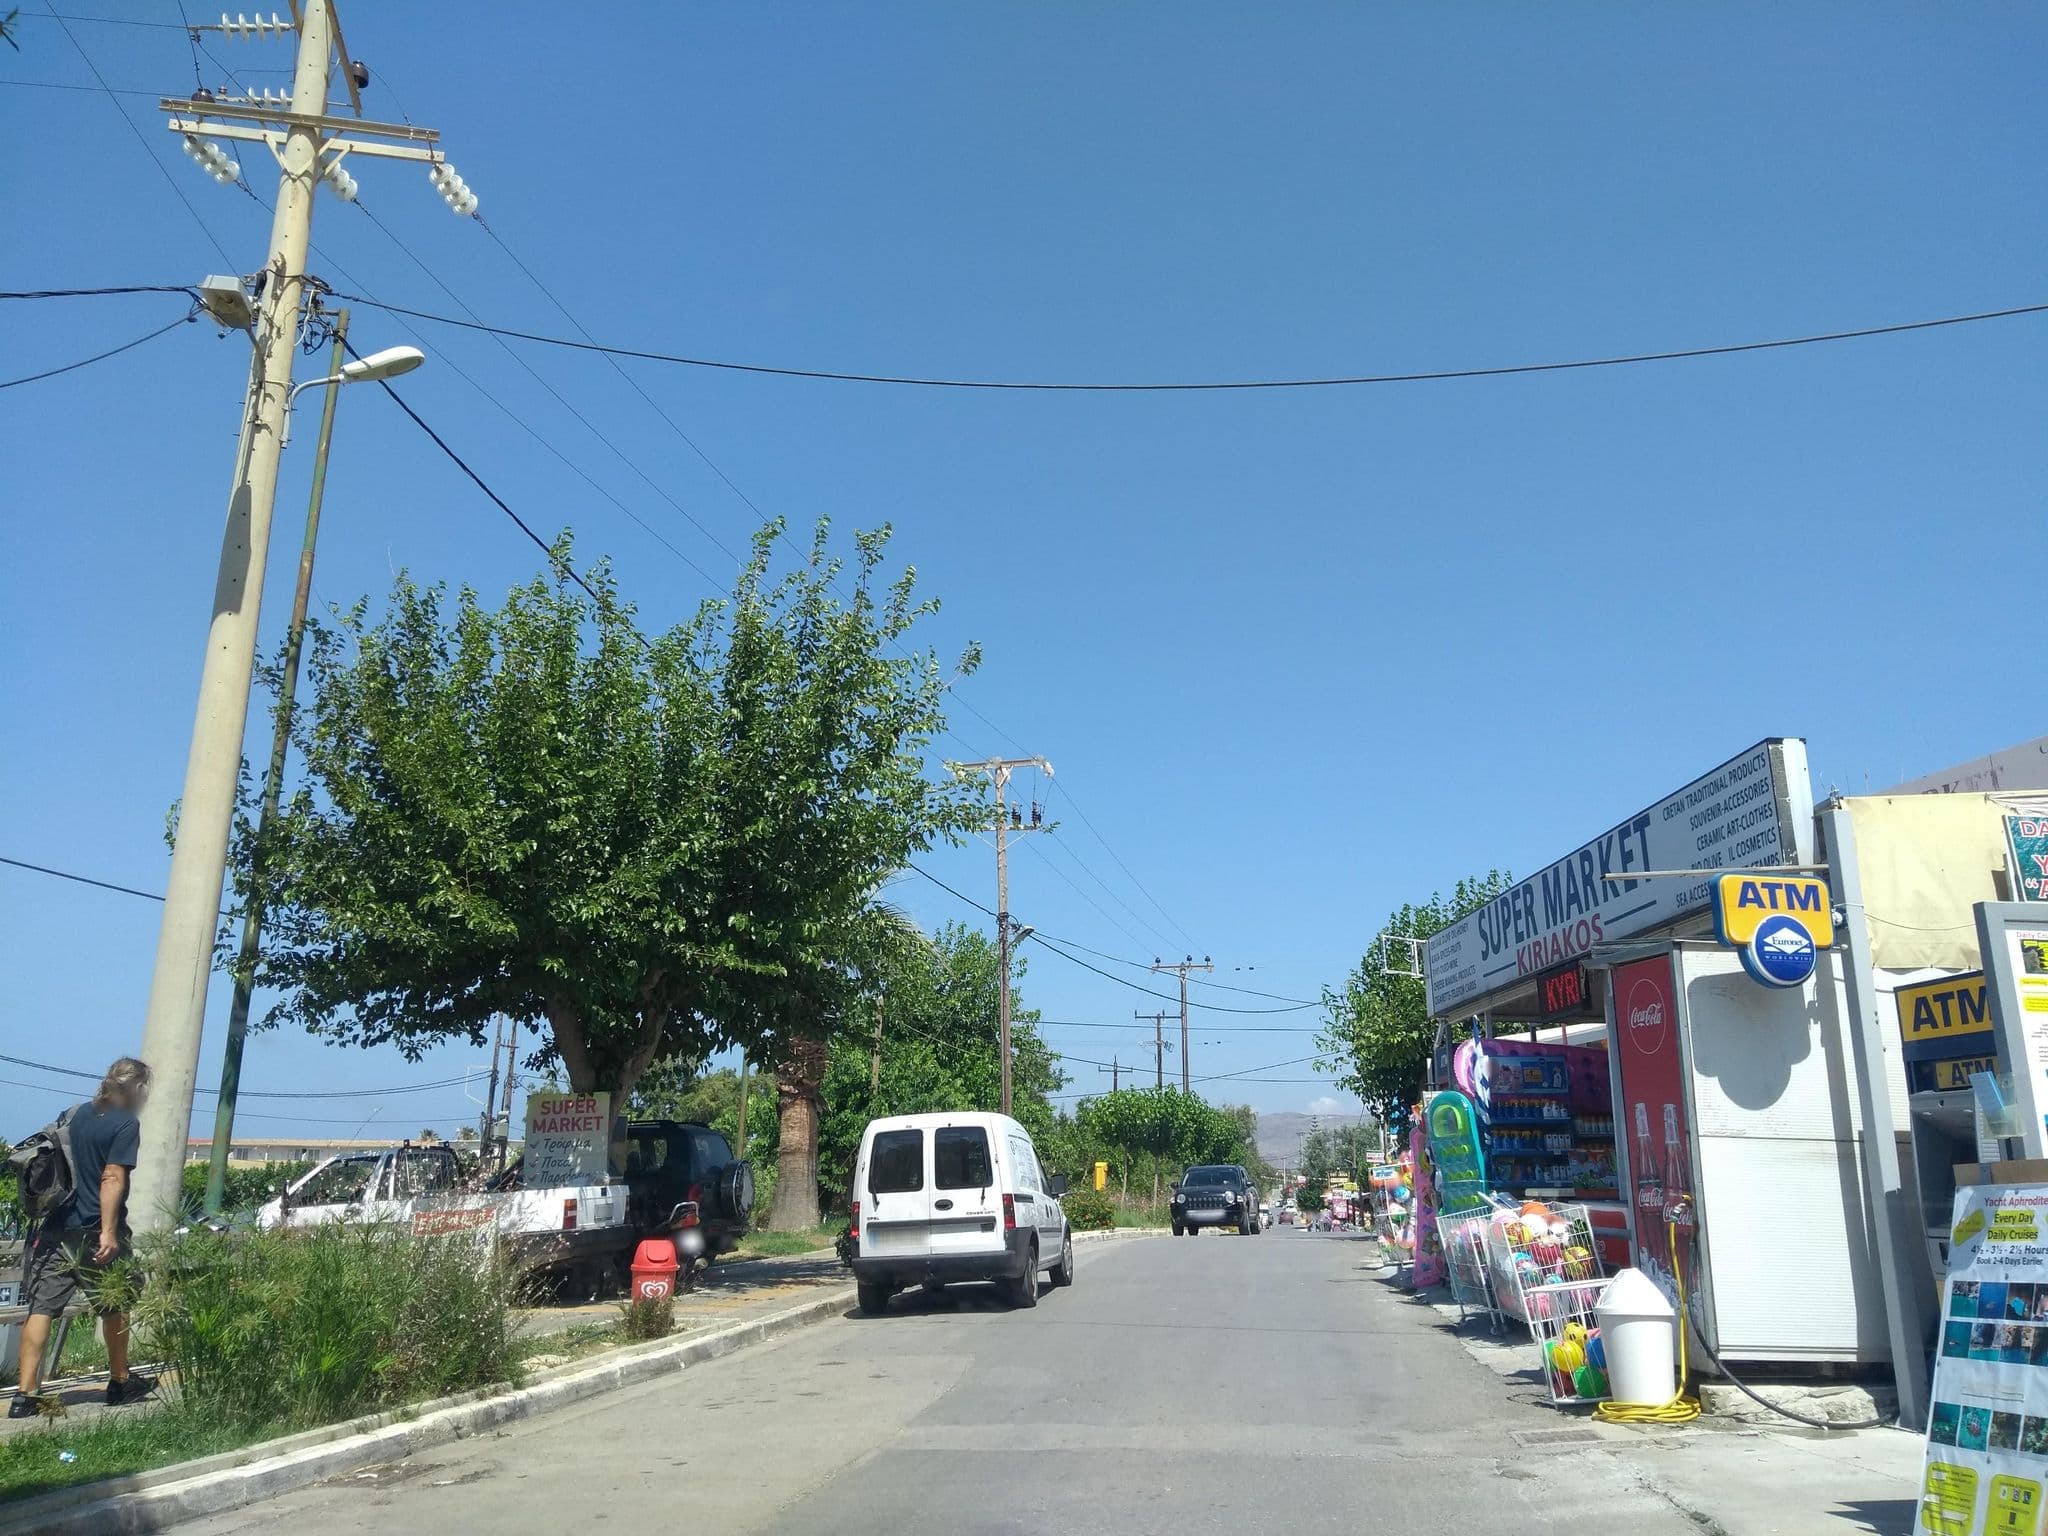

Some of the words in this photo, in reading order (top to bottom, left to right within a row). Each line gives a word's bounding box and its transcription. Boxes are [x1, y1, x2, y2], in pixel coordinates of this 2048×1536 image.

[1663, 794, 1685, 821] CRETAN
[1685, 778, 1728, 808] TRADITIONAL
[1729, 752, 1766, 786] PRODUCTS
[1690, 776, 1770, 831] SOUVENIR-ACCESSORIES
[1696, 825, 1725, 851] CERAMIC
[1726, 802, 1773, 838] ART-CLOTHES
[1703, 851, 1722, 870] OLIVE
[1736, 827, 1777, 858] COSMETICS
[1478, 882, 1539, 961] SUPER
[1541, 813, 1652, 930] MARKET
[1676, 890, 1689, 908] SEA
[1738, 881, 1821, 912] ATM
[1516, 912, 1604, 976] KIRIAKOS
[1772, 936, 1803, 946] Euronet
[1631, 1002, 1663, 1029] Coca-Cola
[1913, 986, 1992, 1032] ATM
[541, 1098, 597, 1115] SUPER
[533, 1115, 604, 1134] MARKET
[1984, 1197, 2006, 1207] Yacht
[2008, 1196, 2048, 1208] Aphrodite
[1994, 1212, 2017, 1225] Every
[2018, 1213, 2035, 1225] Day
[1987, 1230, 2008, 1241] Daily
[2009, 1230, 2039, 1240] Cruises
[1976, 1257, 1991, 1265] Book
[1993, 1257, 2004, 1265] 2-4
[2005, 1257, 2021, 1267] Days
